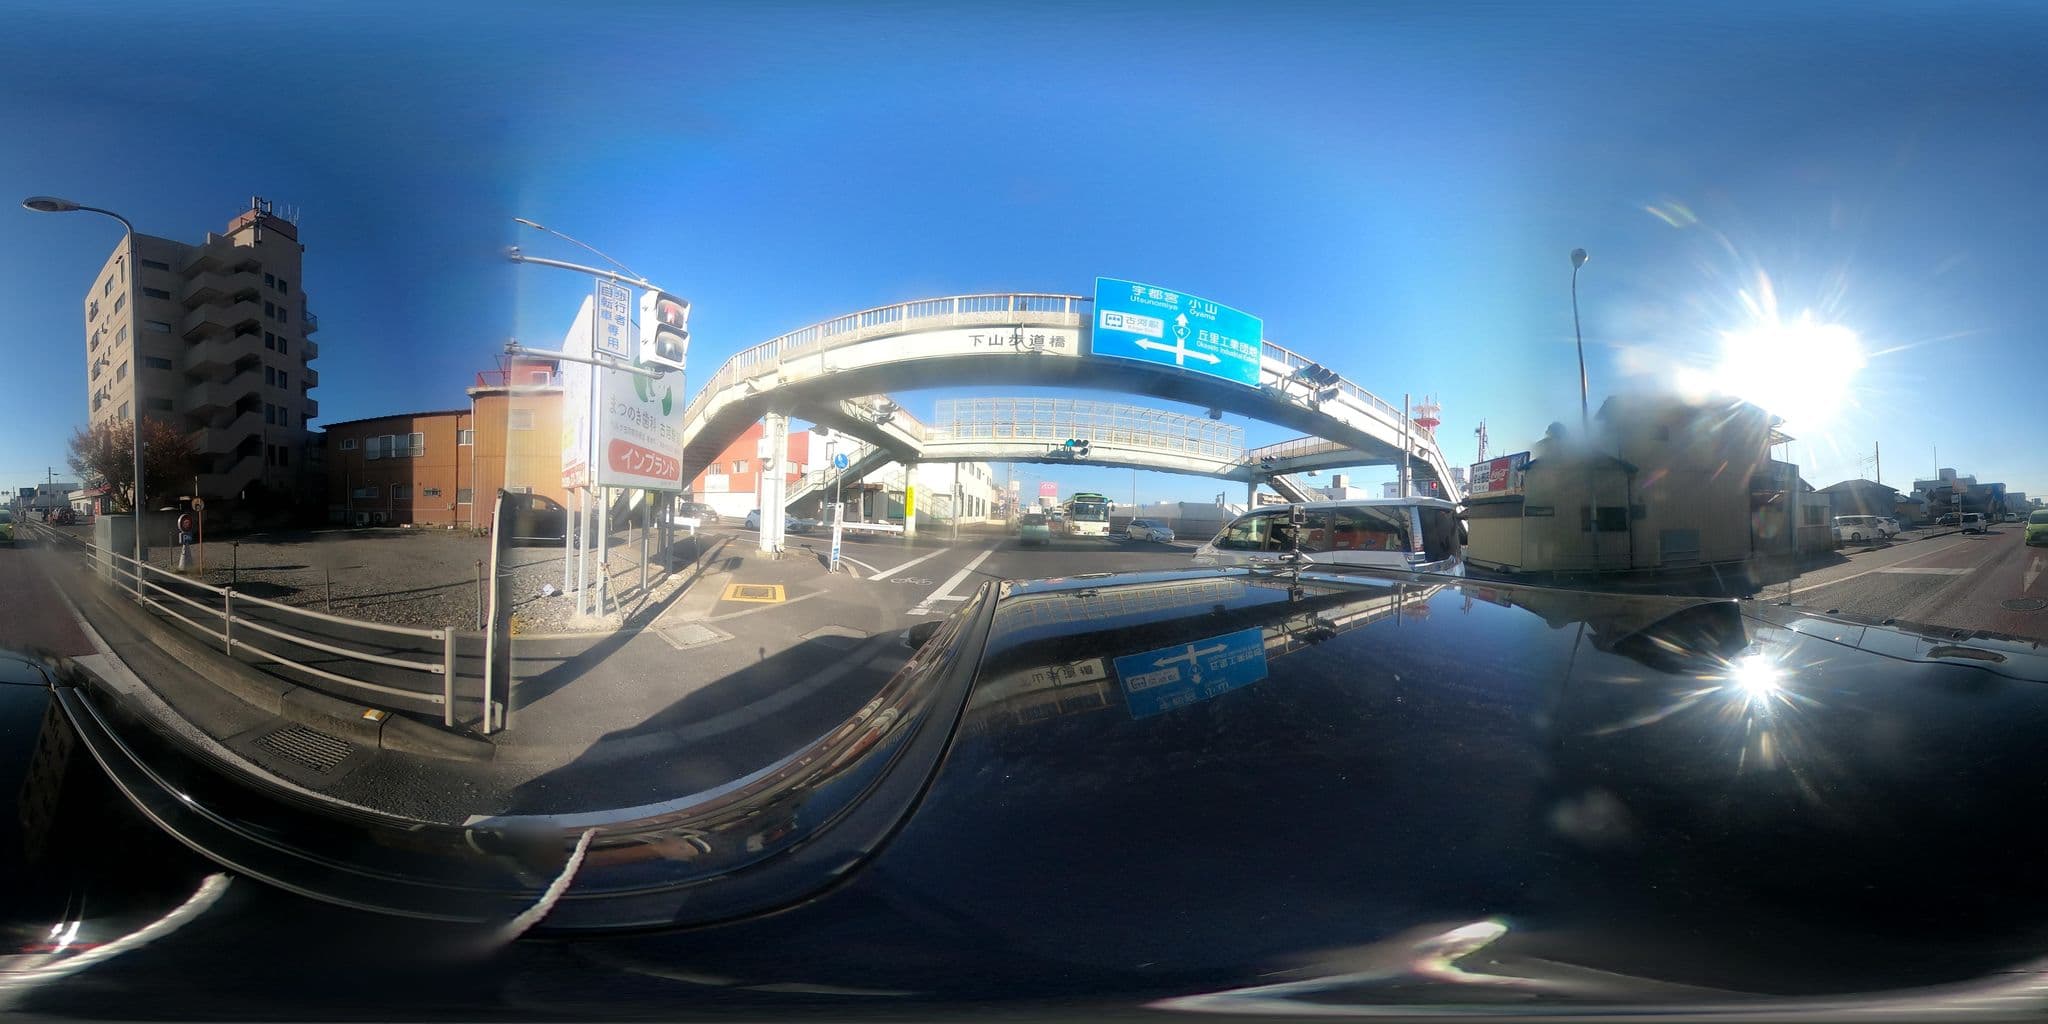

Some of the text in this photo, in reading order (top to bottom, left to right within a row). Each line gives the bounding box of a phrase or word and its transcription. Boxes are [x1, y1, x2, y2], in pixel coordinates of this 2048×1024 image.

[1132, 285, 1217, 315] 宇都宮 小山
[1177, 327, 1184, 336] 4
[968, 334, 1066, 348] 下山歩道橋
